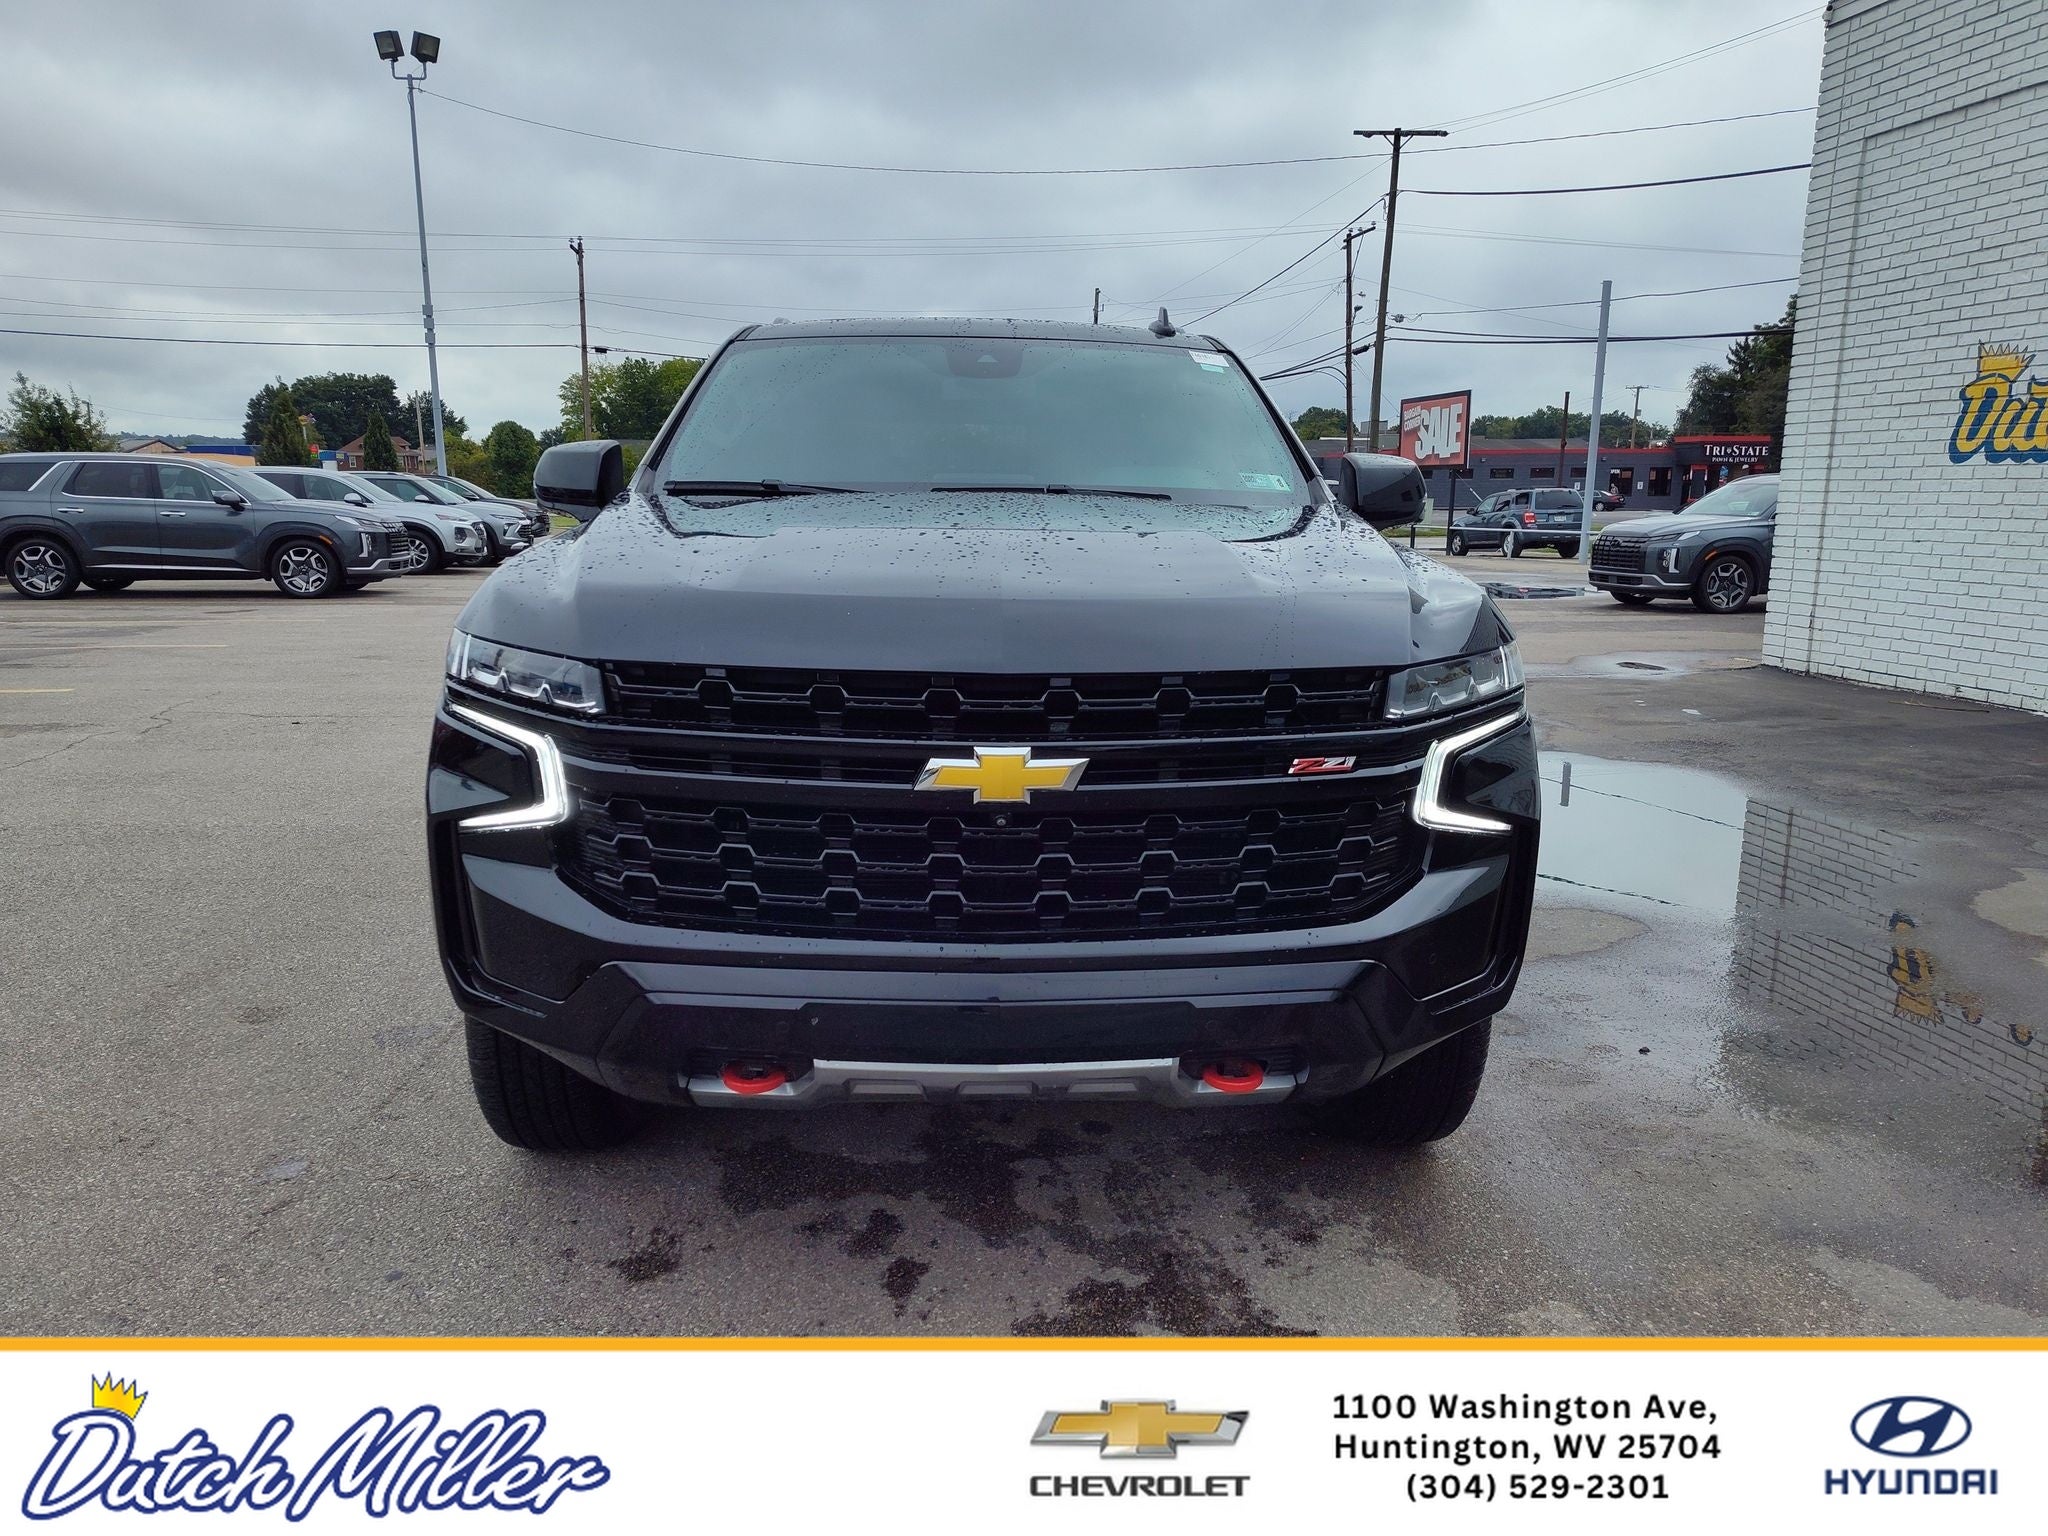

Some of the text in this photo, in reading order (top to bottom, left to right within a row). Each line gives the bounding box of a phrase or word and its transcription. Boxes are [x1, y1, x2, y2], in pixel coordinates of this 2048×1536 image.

[1415, 403, 1462, 459] SALE
[1732, 444, 1769, 456] STATE
[1288, 755, 1357, 774] Z71
